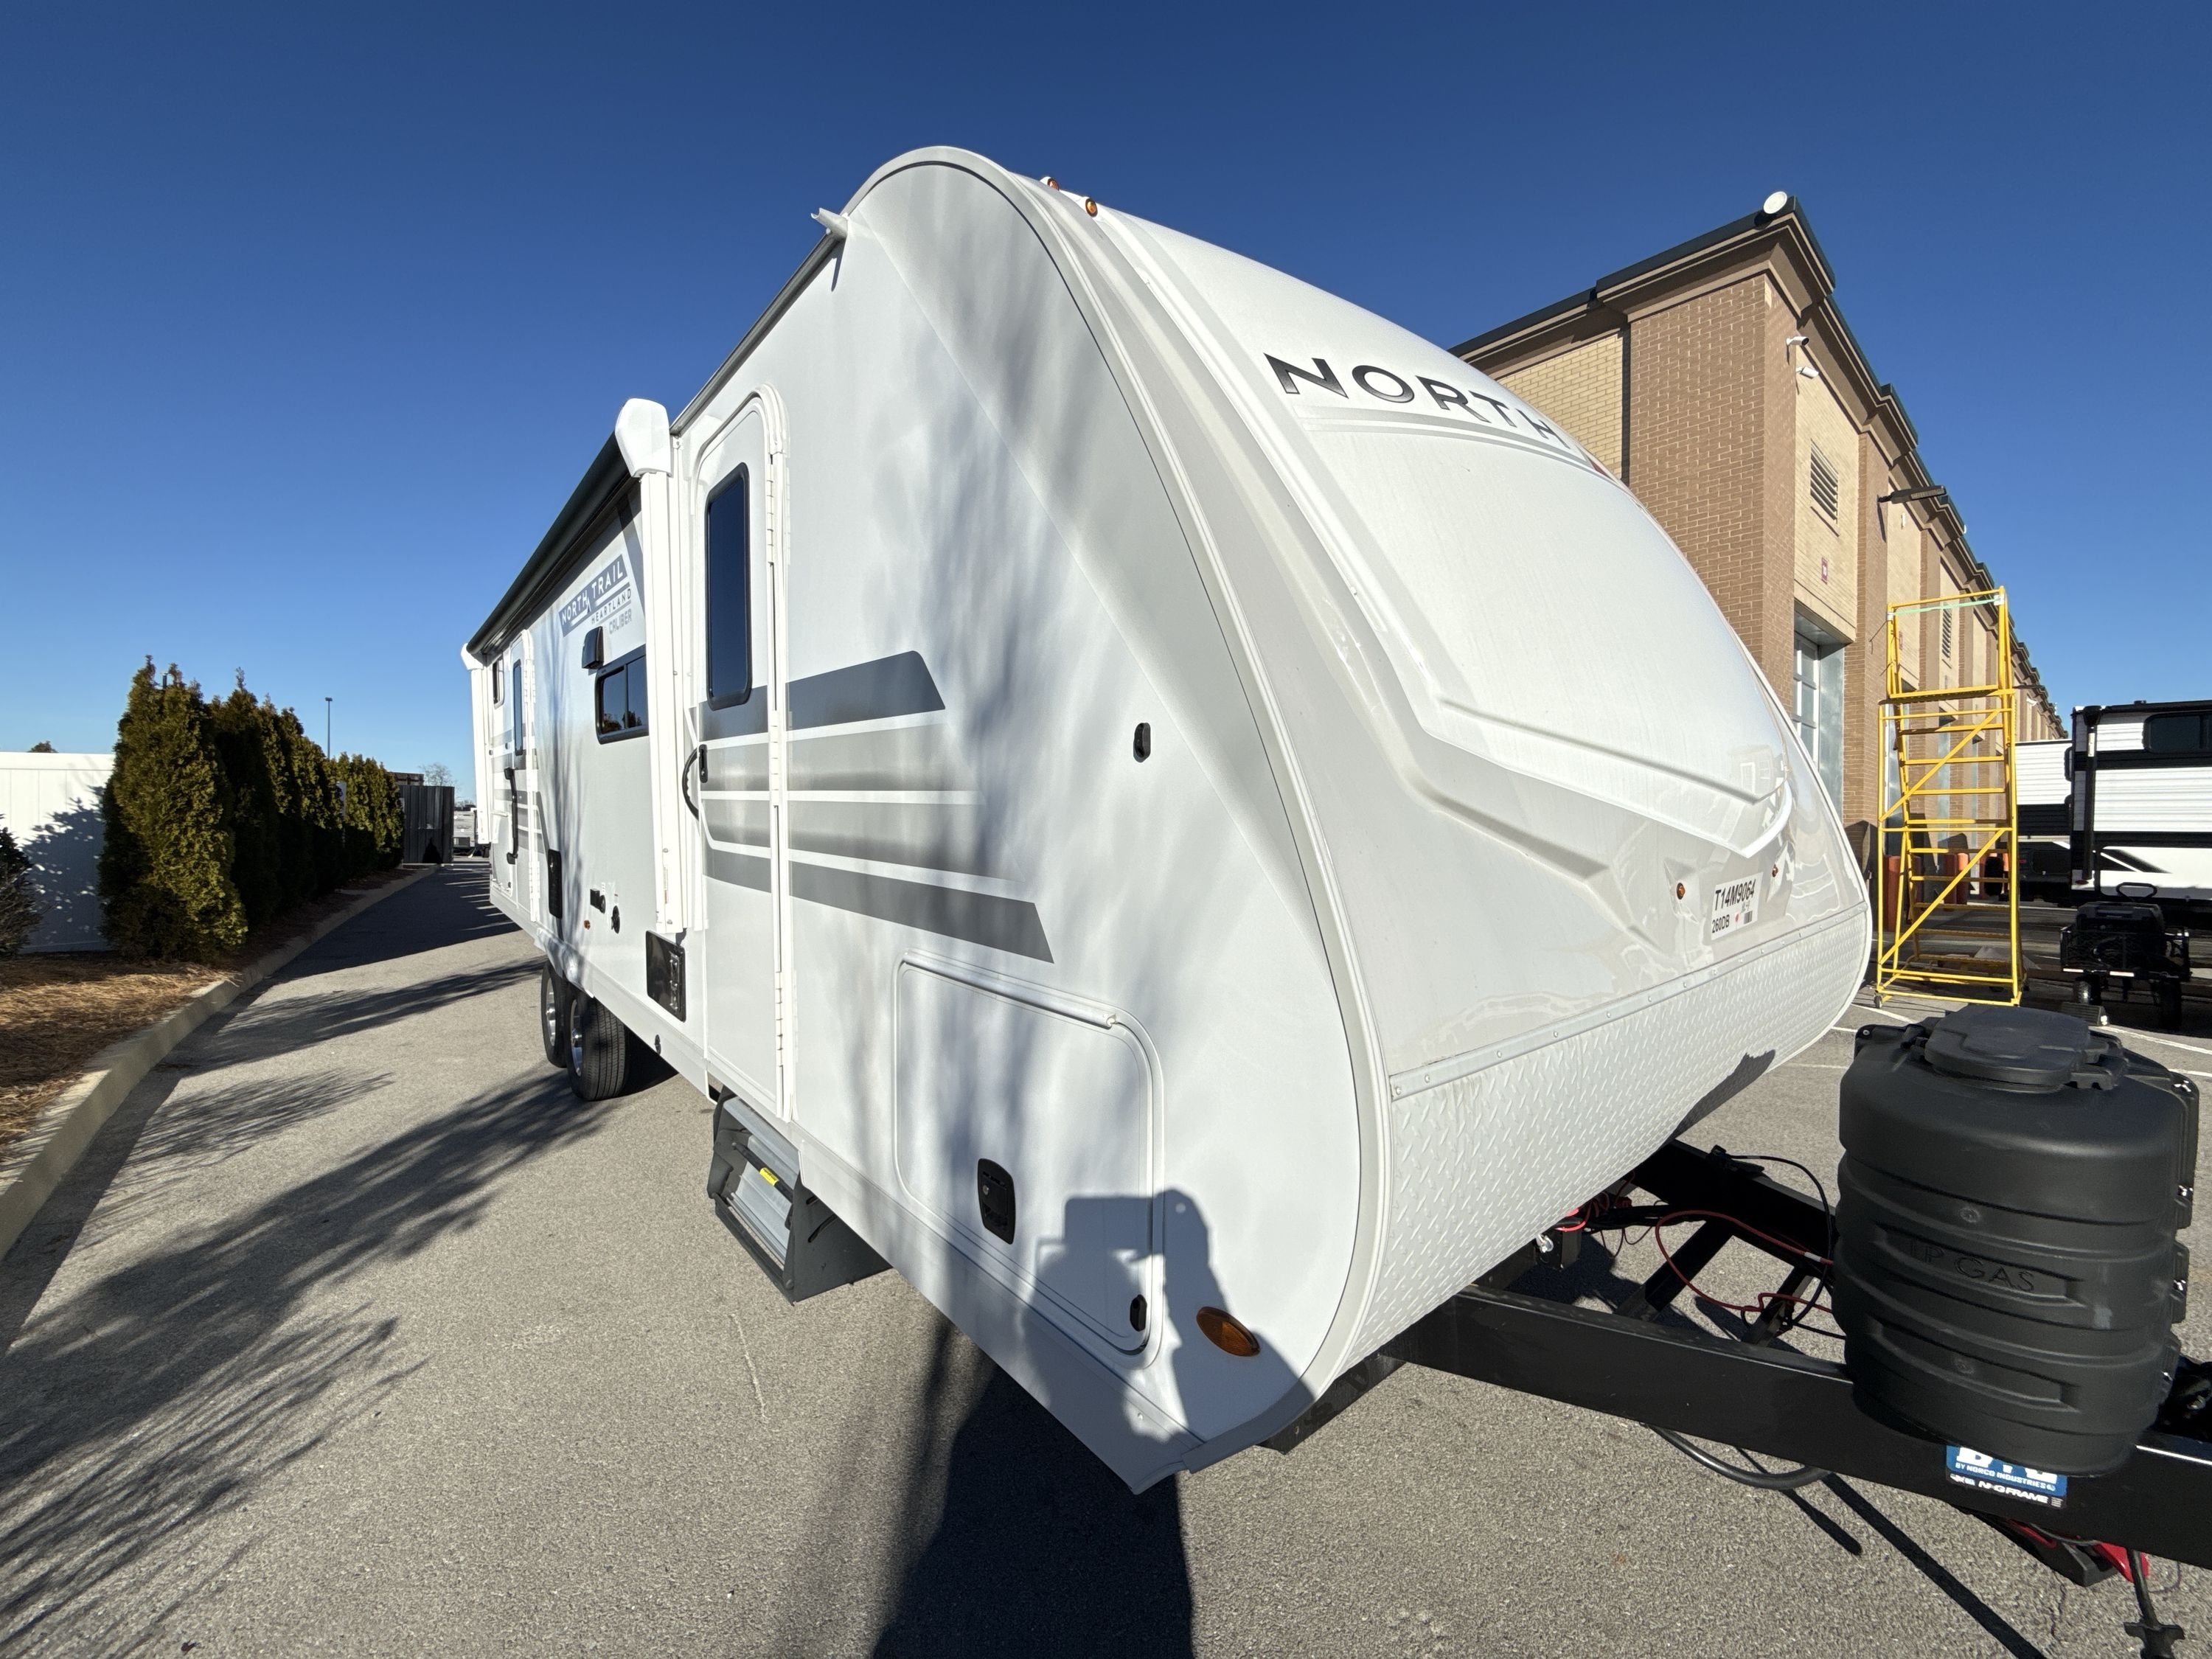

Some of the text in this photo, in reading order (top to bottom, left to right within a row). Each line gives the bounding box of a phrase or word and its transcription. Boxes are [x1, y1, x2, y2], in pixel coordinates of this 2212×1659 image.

[1264, 352, 1571, 448] NORTH
[561, 561, 623, 625] NORTH TRAIL
[591, 588, 632, 625] HEARTLAND
[608, 608, 632, 634] CALIBER
[1715, 879, 1756, 911] T14M9064
[1711, 914, 1730, 933] 260DB
[1954, 1256, 2035, 1293] GAS
[1966, 1465, 1996, 1477] NORCO
[1996, 1472, 2047, 1489] INDUSTRIES
[2006, 1486, 2049, 1504] FRAME
